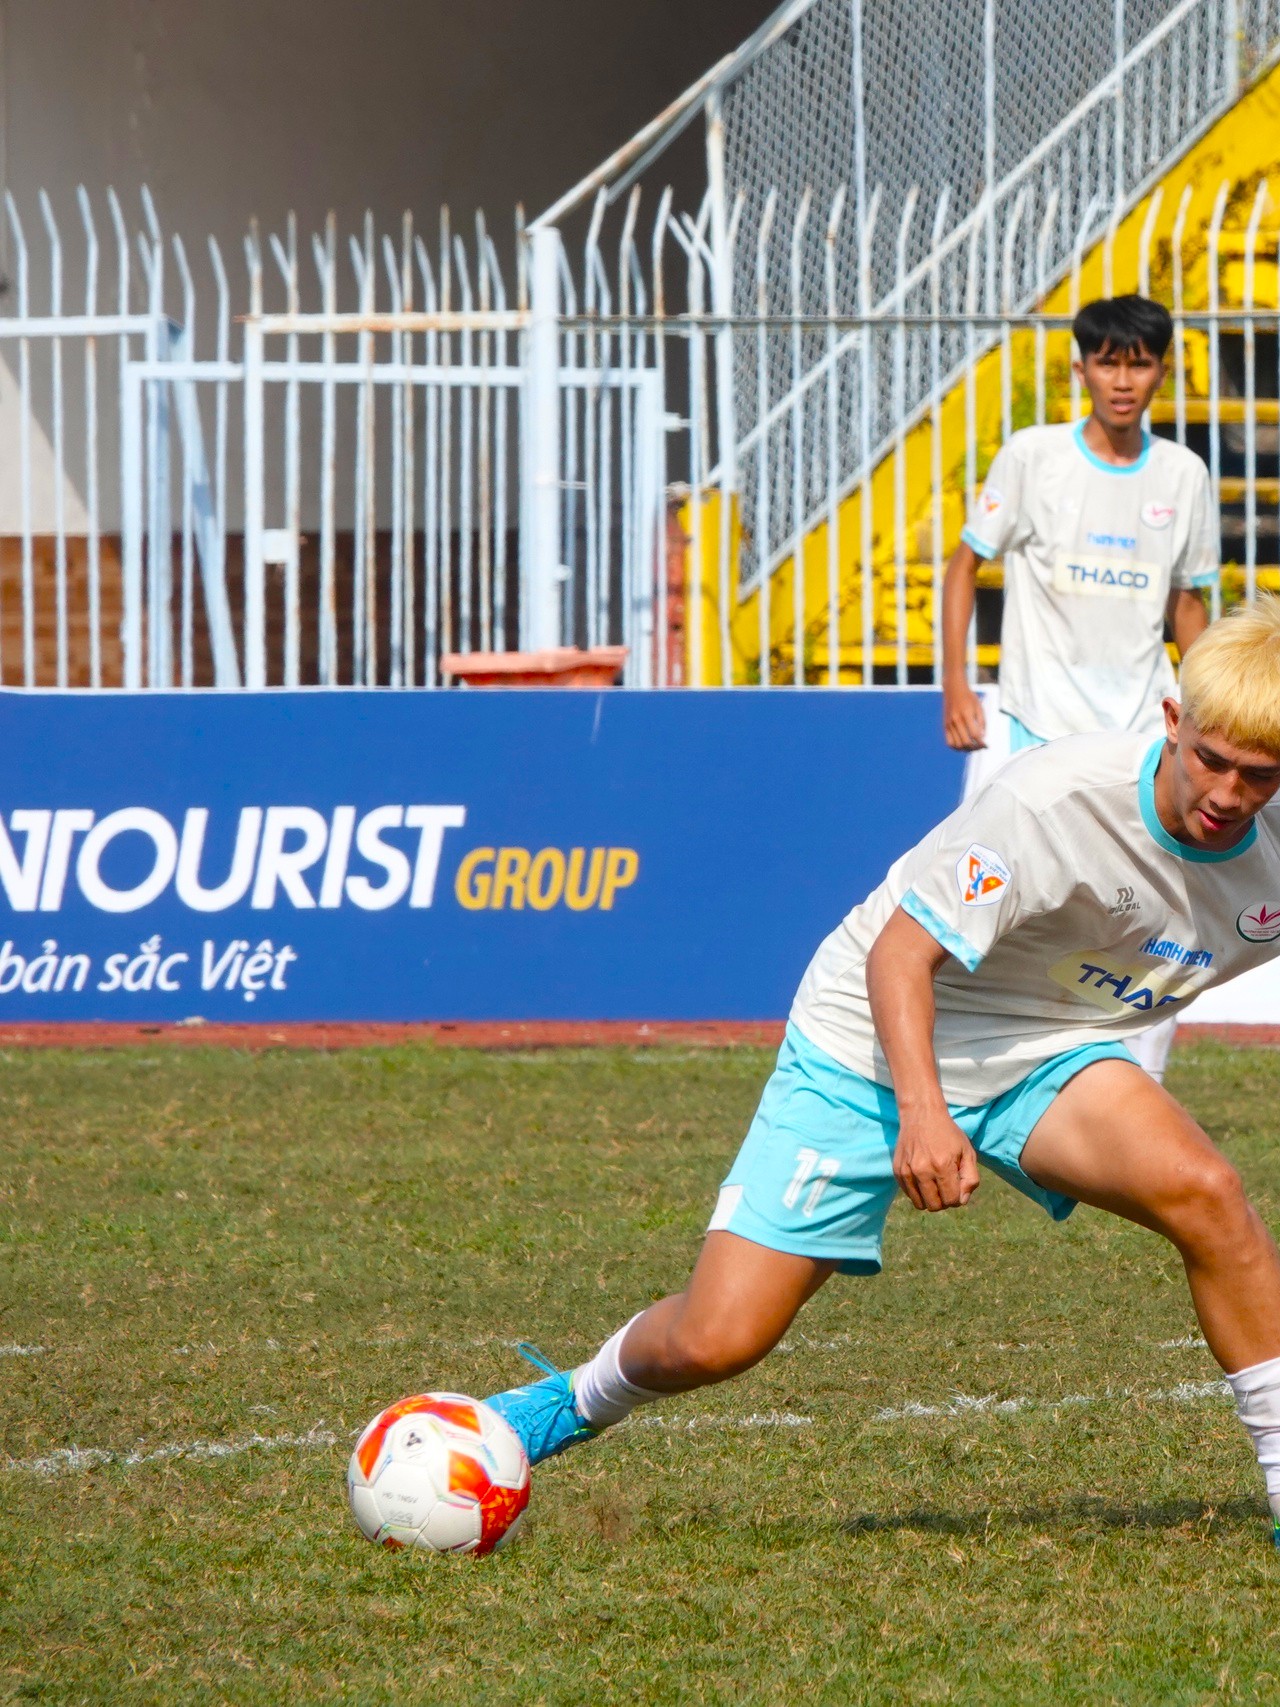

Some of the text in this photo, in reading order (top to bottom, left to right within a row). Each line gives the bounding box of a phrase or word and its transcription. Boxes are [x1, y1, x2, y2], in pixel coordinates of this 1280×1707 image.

[1067, 564, 1149, 589] THACO
[455, 848, 638, 910] GROUP
[0, 934, 298, 1001] bản sắc Việt
[1078, 963, 1183, 1011] THA
[783, 1147, 842, 1218] 11
